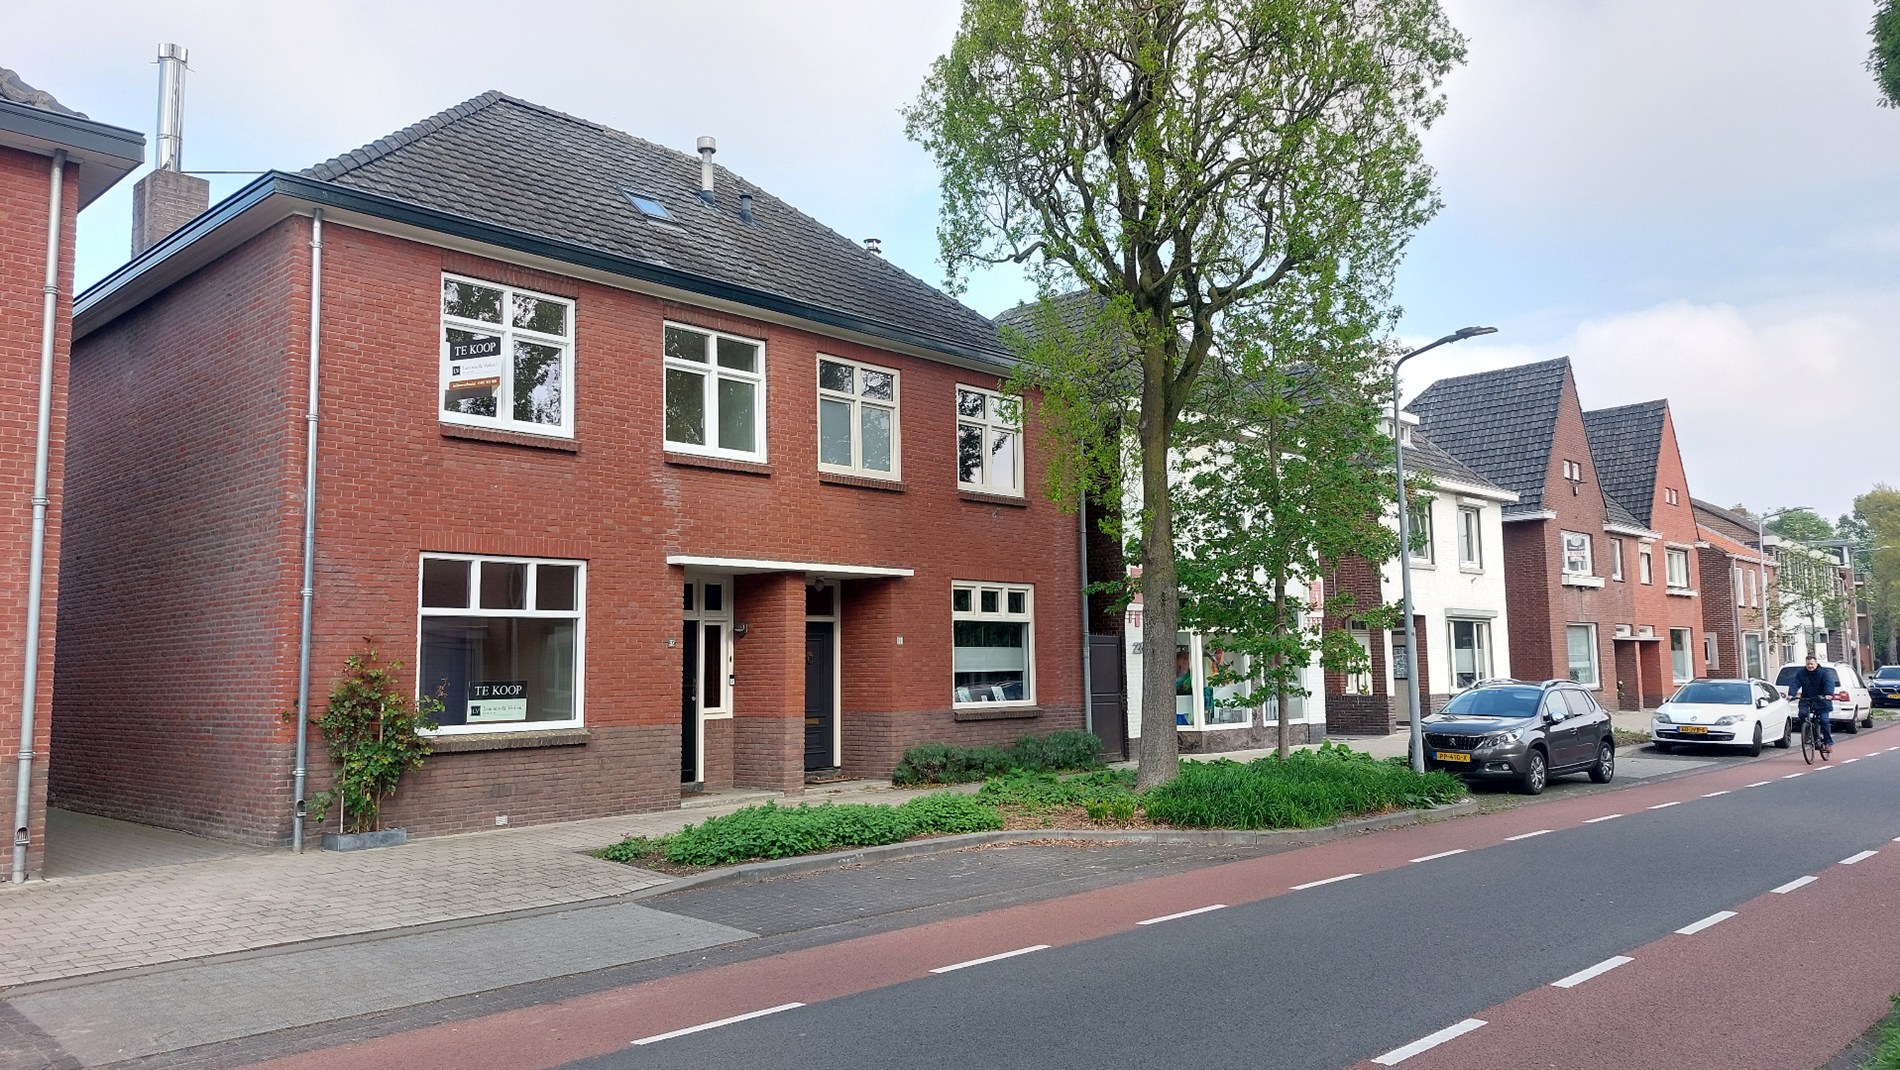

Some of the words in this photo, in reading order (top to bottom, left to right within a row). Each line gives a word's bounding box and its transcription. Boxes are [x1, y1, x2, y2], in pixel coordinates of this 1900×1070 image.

[455, 345, 468, 356] TE
[469, 342, 496, 355] KOOP
[474, 685, 490, 696] TE
[491, 684, 523, 696] KOOP
